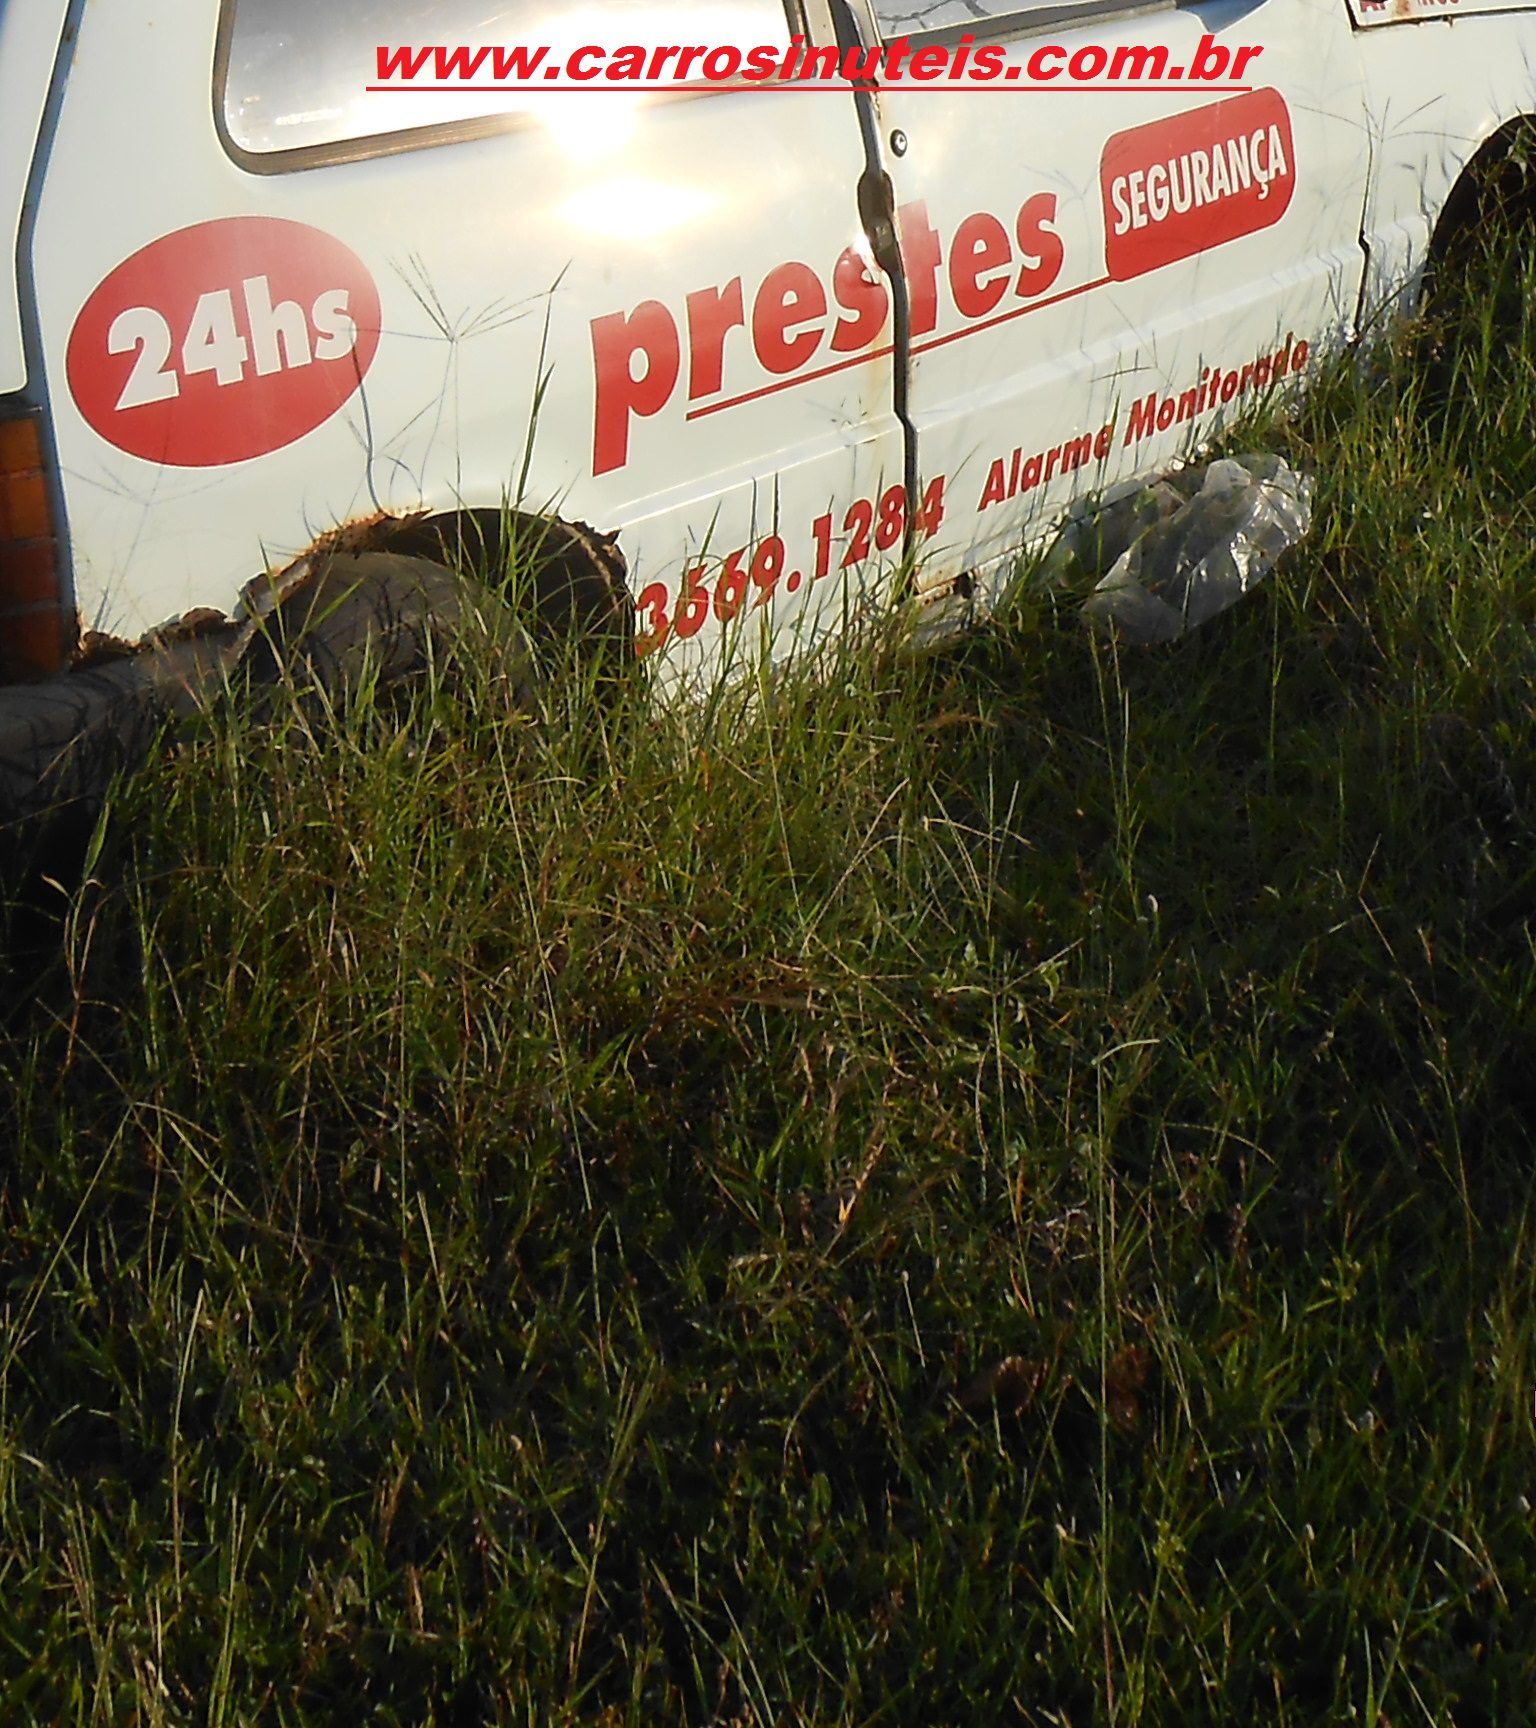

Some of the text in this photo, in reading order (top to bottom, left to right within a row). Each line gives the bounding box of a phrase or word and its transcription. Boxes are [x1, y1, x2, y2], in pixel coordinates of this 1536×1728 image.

[107, 274, 358, 413] 24hs
[590, 123, 1289, 478] prestes SEGURANÇA
[976, 331, 1310, 512] Alarme Monitorado
[634, 474, 947, 659] 3669.1284
